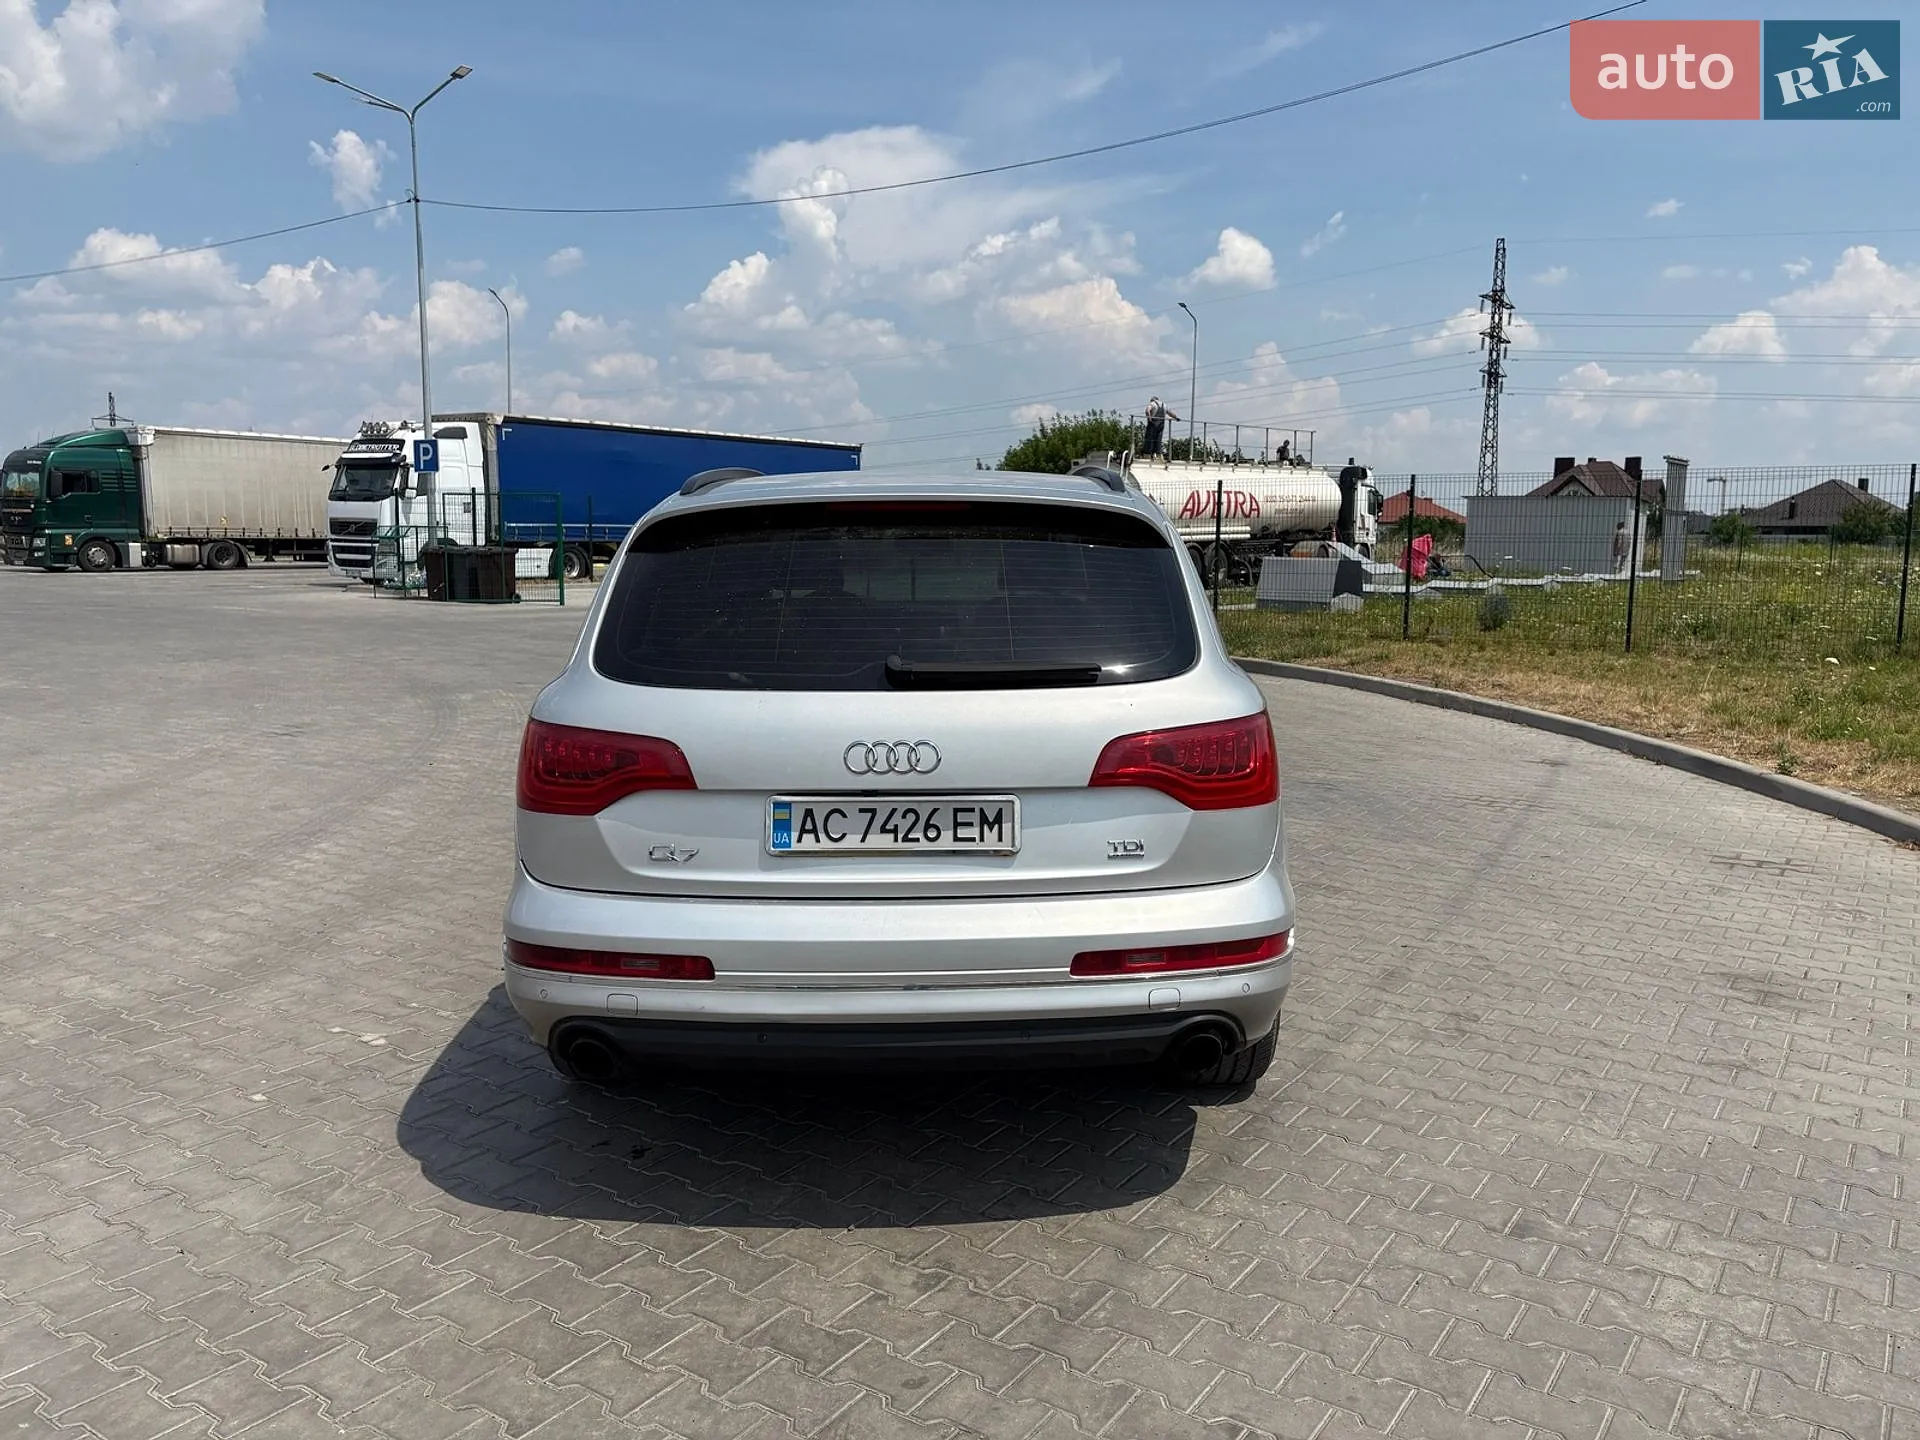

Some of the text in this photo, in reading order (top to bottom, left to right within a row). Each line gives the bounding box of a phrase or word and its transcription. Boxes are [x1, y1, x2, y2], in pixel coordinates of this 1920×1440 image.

[420, 443, 433, 469] P
[796, 807, 1003, 844] AC 7426 EM
[773, 833, 789, 844] UA
[648, 843, 699, 862] Q7
[1107, 840, 1144, 857] TDI
